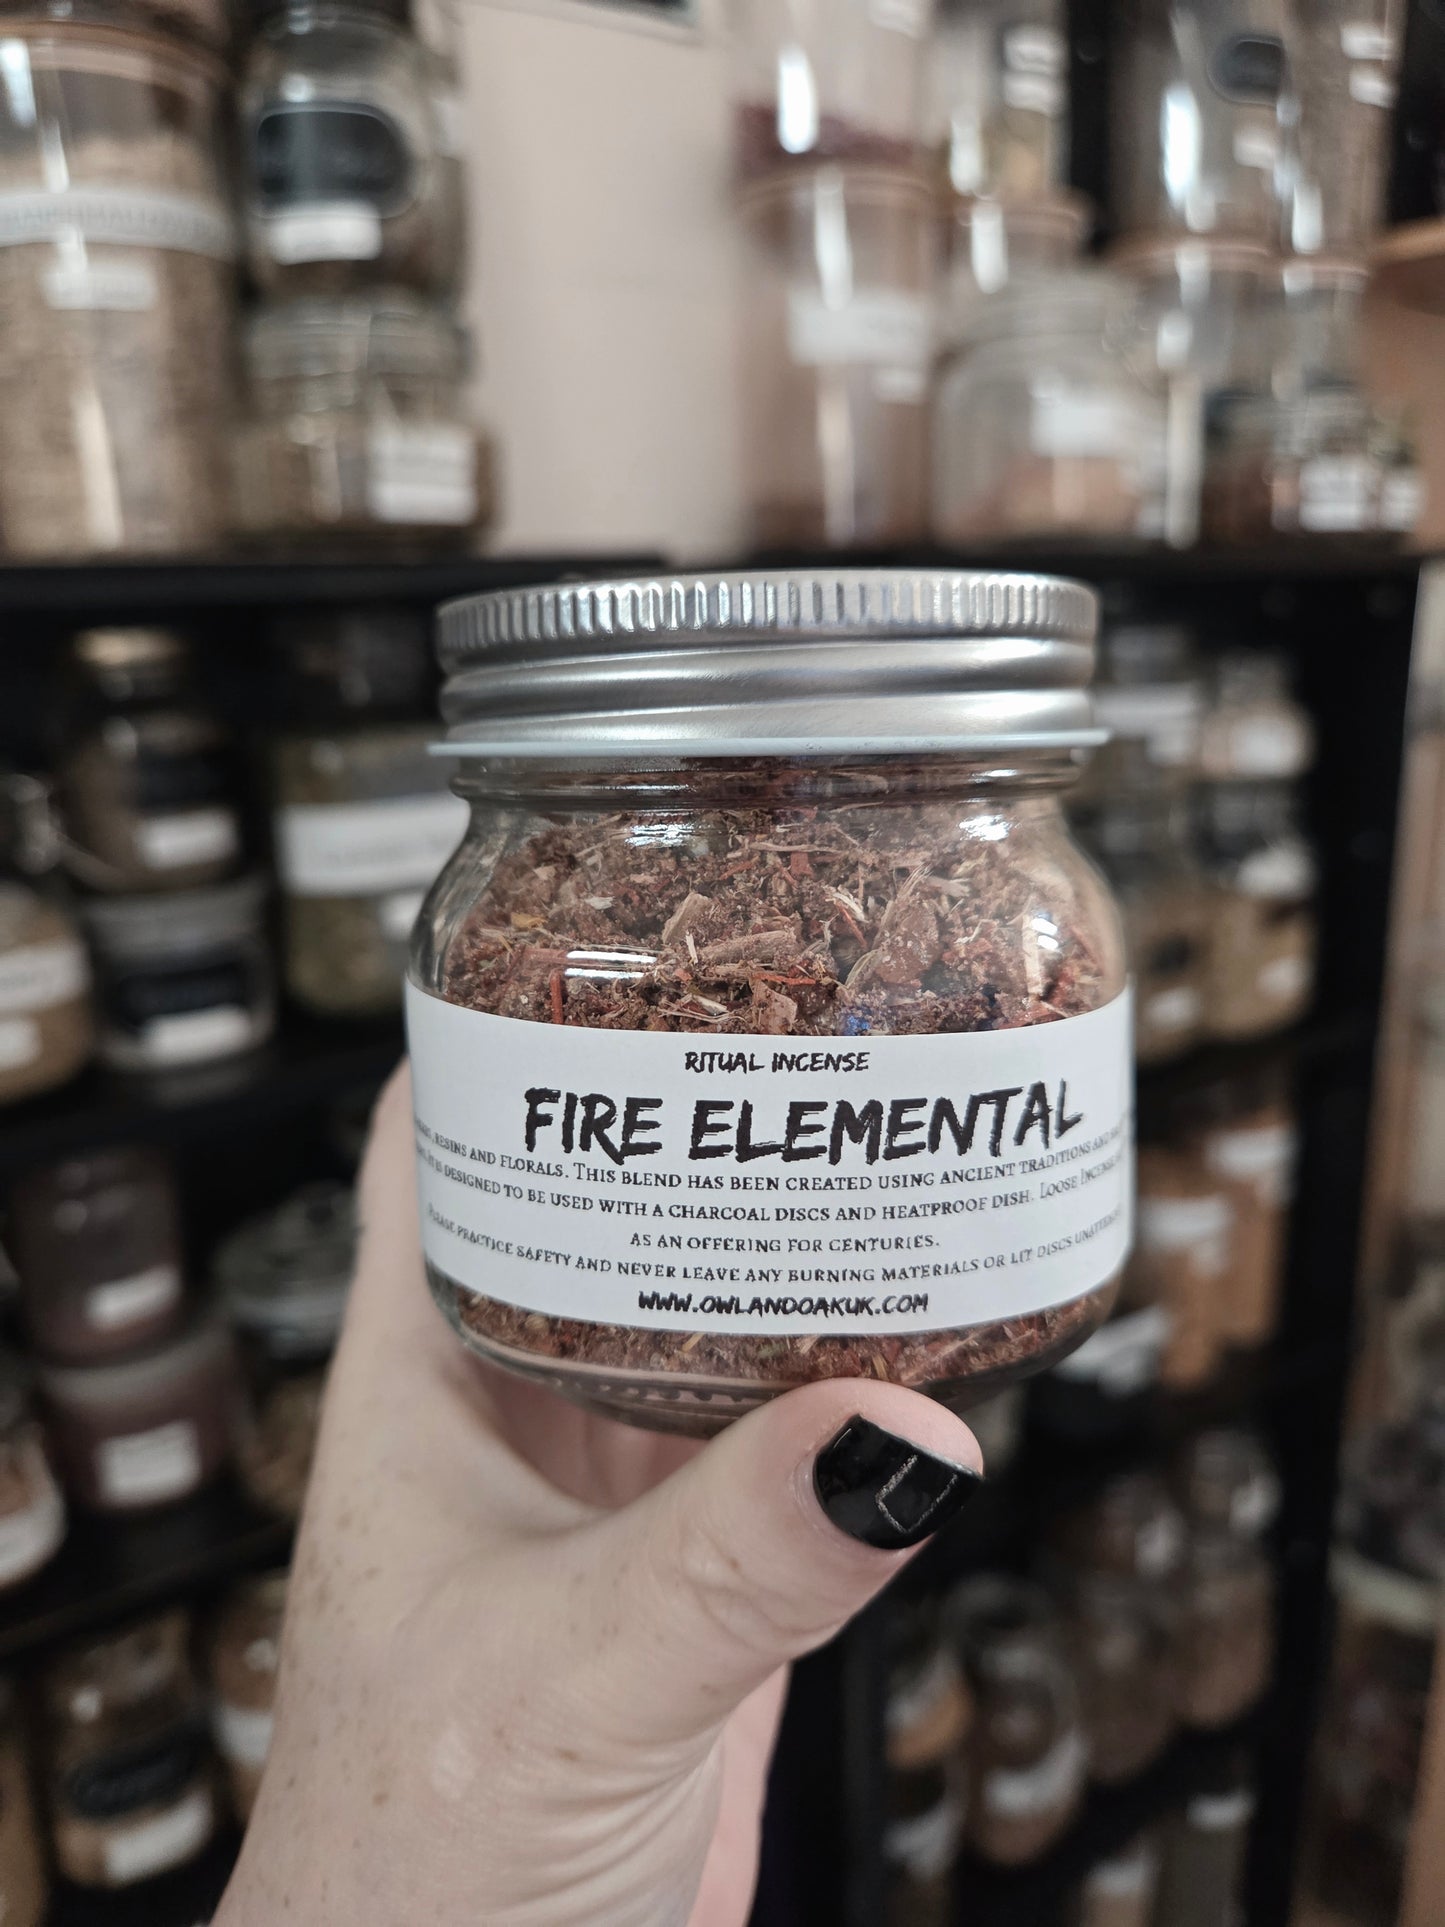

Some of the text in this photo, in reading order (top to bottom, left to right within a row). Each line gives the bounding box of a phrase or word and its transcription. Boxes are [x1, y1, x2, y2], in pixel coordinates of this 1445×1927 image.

[684, 1051, 870, 1075] RITUAL INCENSE
[524, 1077, 1083, 1166] FIRE ELEMENTAL
[469, 1147, 497, 1165] AND
[621, 1171, 682, 1188] BLEND
[687, 1174, 724, 1190] HAS
[730, 1176, 780, 1191] BEEN
[785, 1176, 872, 1191] CREATED
[878, 1172, 935, 1190] USING
[939, 1162, 1016, 1185] ANCIENT
[1018, 1140, 1091, 1175] TRADITIONS
[444, 1164, 502, 1195] DESIGNED
[503, 1183, 523, 1200] TO
[527, 1188, 547, 1204] BE
[550, 1192, 594, 1211] USED
[598, 1199, 648, 1217] WITH
[652, 1204, 665, 1218] A
[668, 1204, 771, 1221] CHARCOAL
[775, 1207, 831, 1222] DISCS
[835, 1206, 877, 1221] AND
[882, 1197, 988, 1220] HEATPROOF
[456, 1225, 514, 1255] PRACTICE
[516, 1245, 573, 1266] SAFETY
[574, 1255, 613, 1273] AND
[617, 1261, 677, 1279] NEVER
[682, 1266, 741, 1282] LEAVE
[744, 1267, 784, 1283] ANY
[787, 1268, 876, 1284] BURNING
[881, 1258, 979, 1282] MATERIALS
[982, 1254, 1006, 1270] OR
[1009, 1247, 1034, 1265] LIT
[1036, 1235, 1073, 1259] DISCS
[630, 1232, 941, 1253] AS AN OFFERING FOR CENTURIES.
[638, 1290, 930, 1318] WWW.OWLANDOAKUK.COM
